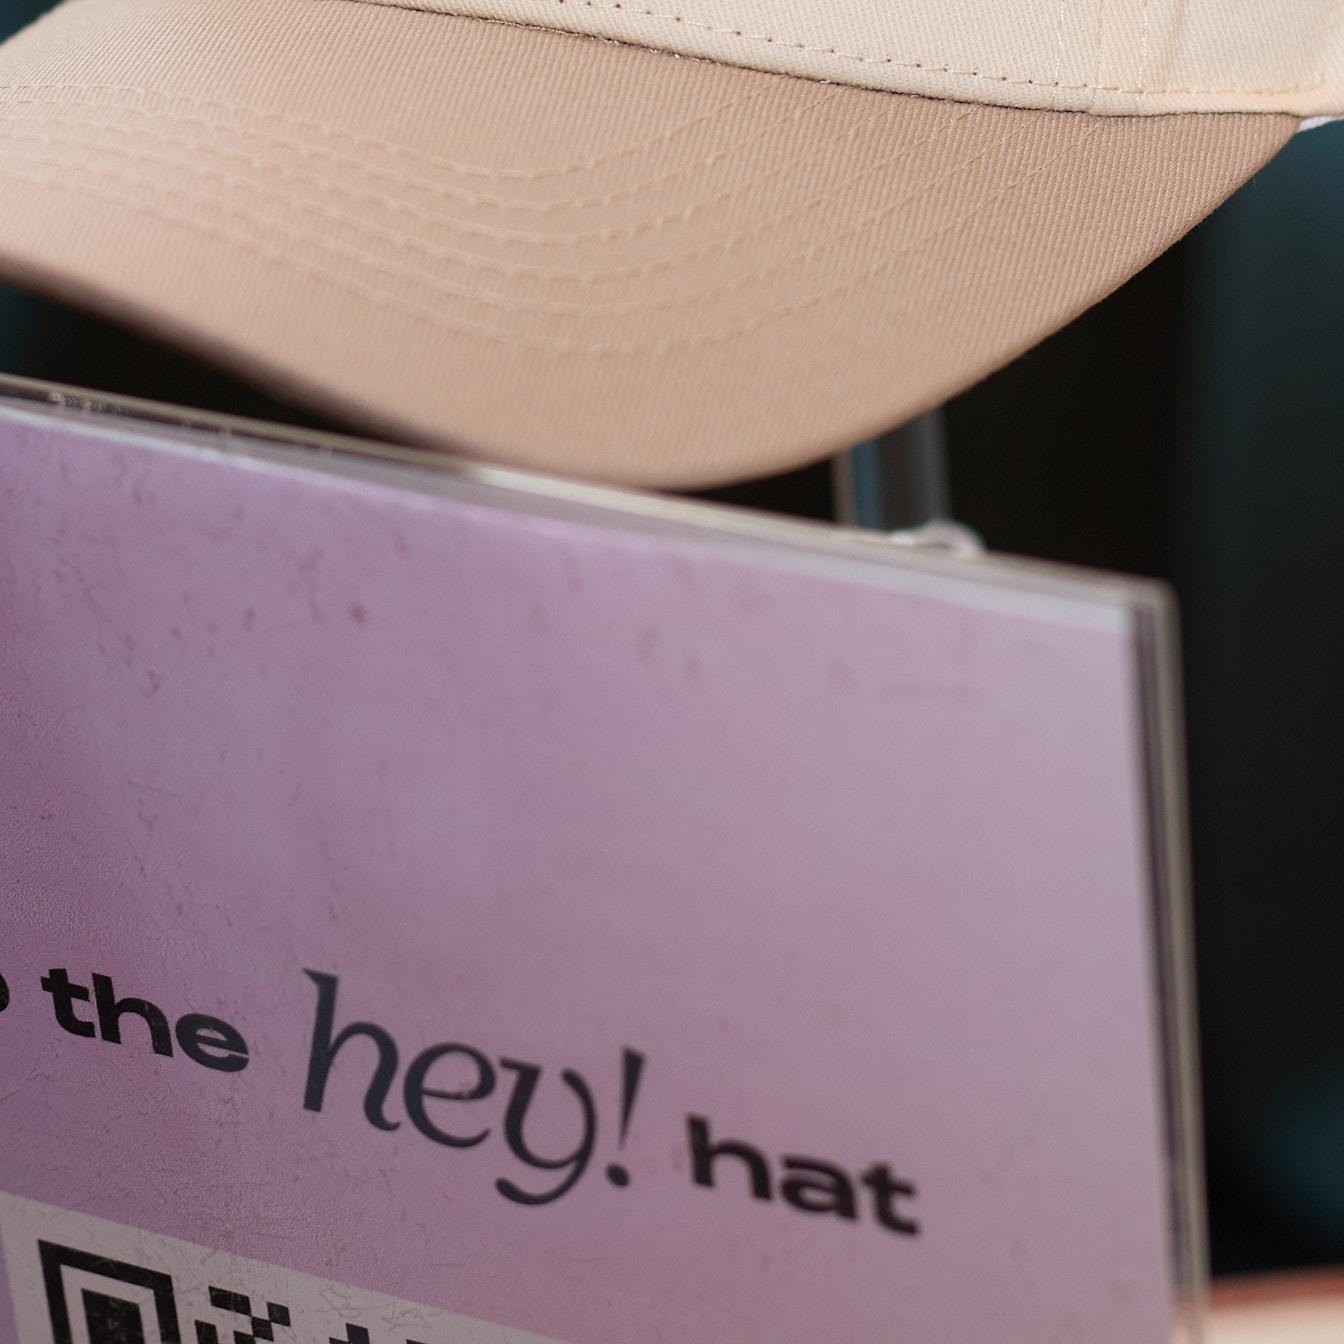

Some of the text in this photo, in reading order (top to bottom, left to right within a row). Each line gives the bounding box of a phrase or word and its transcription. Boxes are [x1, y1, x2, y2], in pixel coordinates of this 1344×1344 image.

[40, 967, 250, 1072] the
[301, 968, 646, 1205] hey!
[687, 1113, 920, 1235] hat
